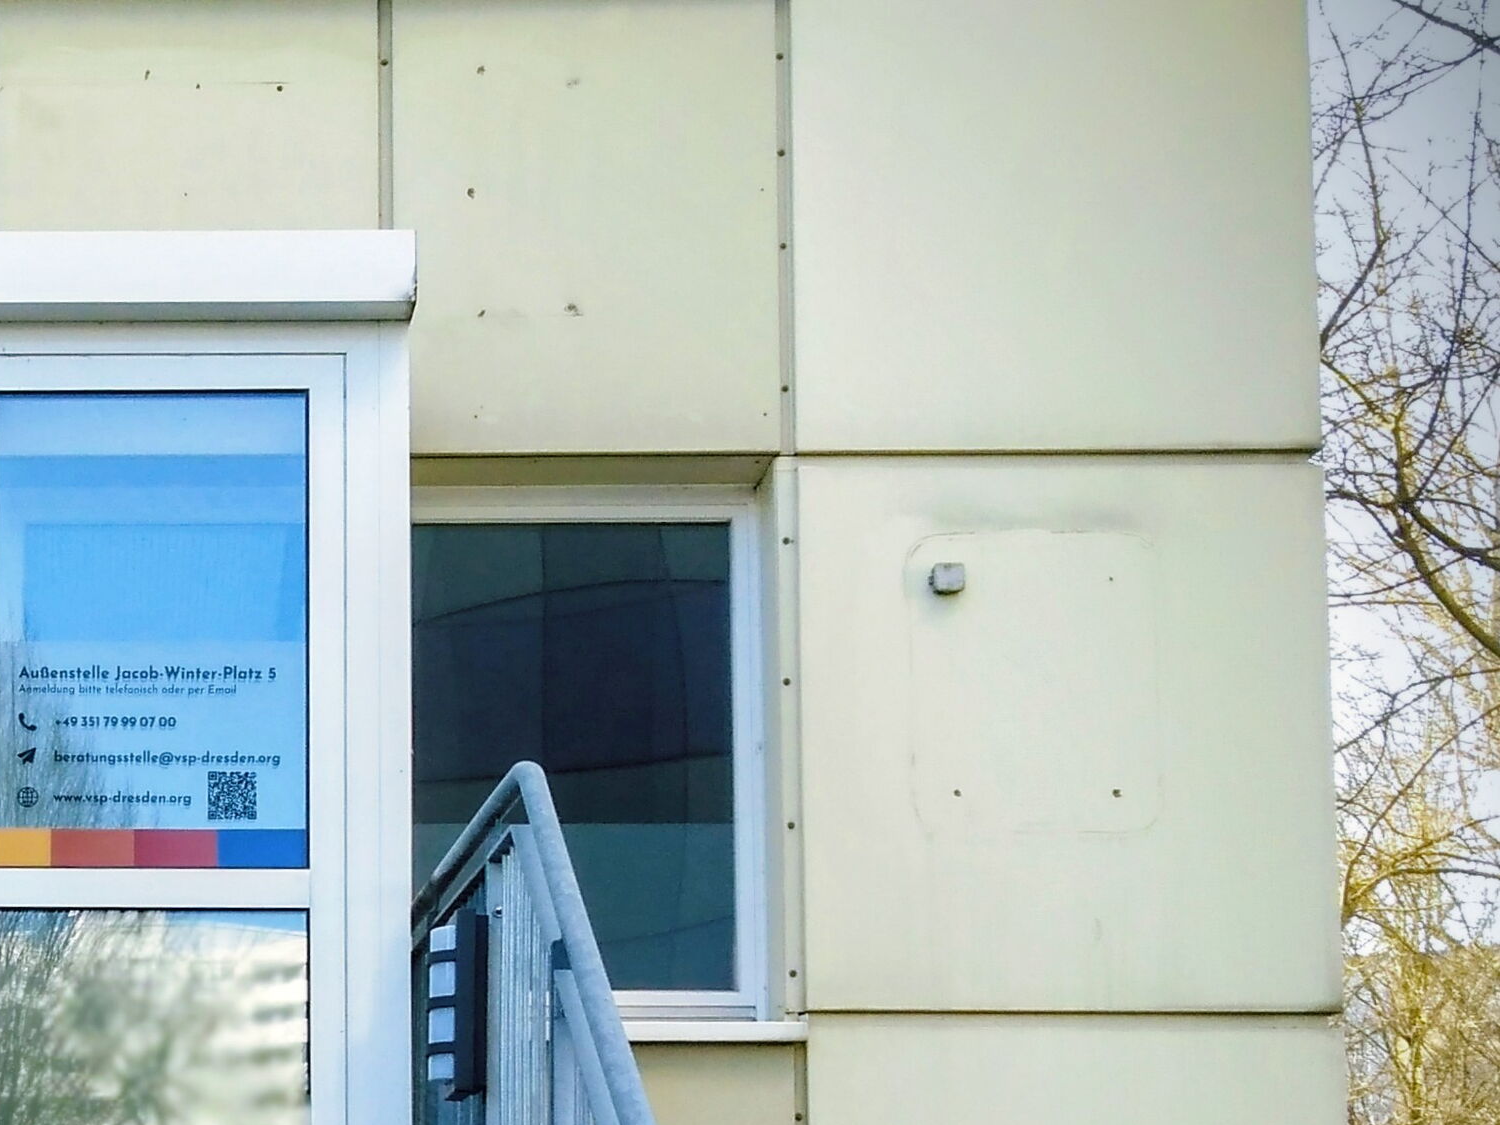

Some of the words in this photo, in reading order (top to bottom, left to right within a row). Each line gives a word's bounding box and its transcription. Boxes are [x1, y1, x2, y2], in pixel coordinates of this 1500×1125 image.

[18, 665, 110, 679] Außenstelle
[114, 665, 263, 681] Jacob-Winter-Platz
[267, 667, 277, 680] 5
[18, 684, 75, 696] Anmeldung
[79, 684, 102, 694] bitte
[161, 685, 185, 695] oder
[188, 687, 205, 699] per
[207, 685, 237, 695] Email
[55, 716, 78, 728] +49
[80, 716, 100, 727] 351
[103, 716, 119, 728] 79
[121, 717, 137, 728] 99
[139, 717, 156, 728] 07
[158, 717, 177, 728] 00
[54, 750, 281, 767] beratungsstelle@vsp-dresden.org
[53, 791, 192, 806] www.vsp-dresden.org
